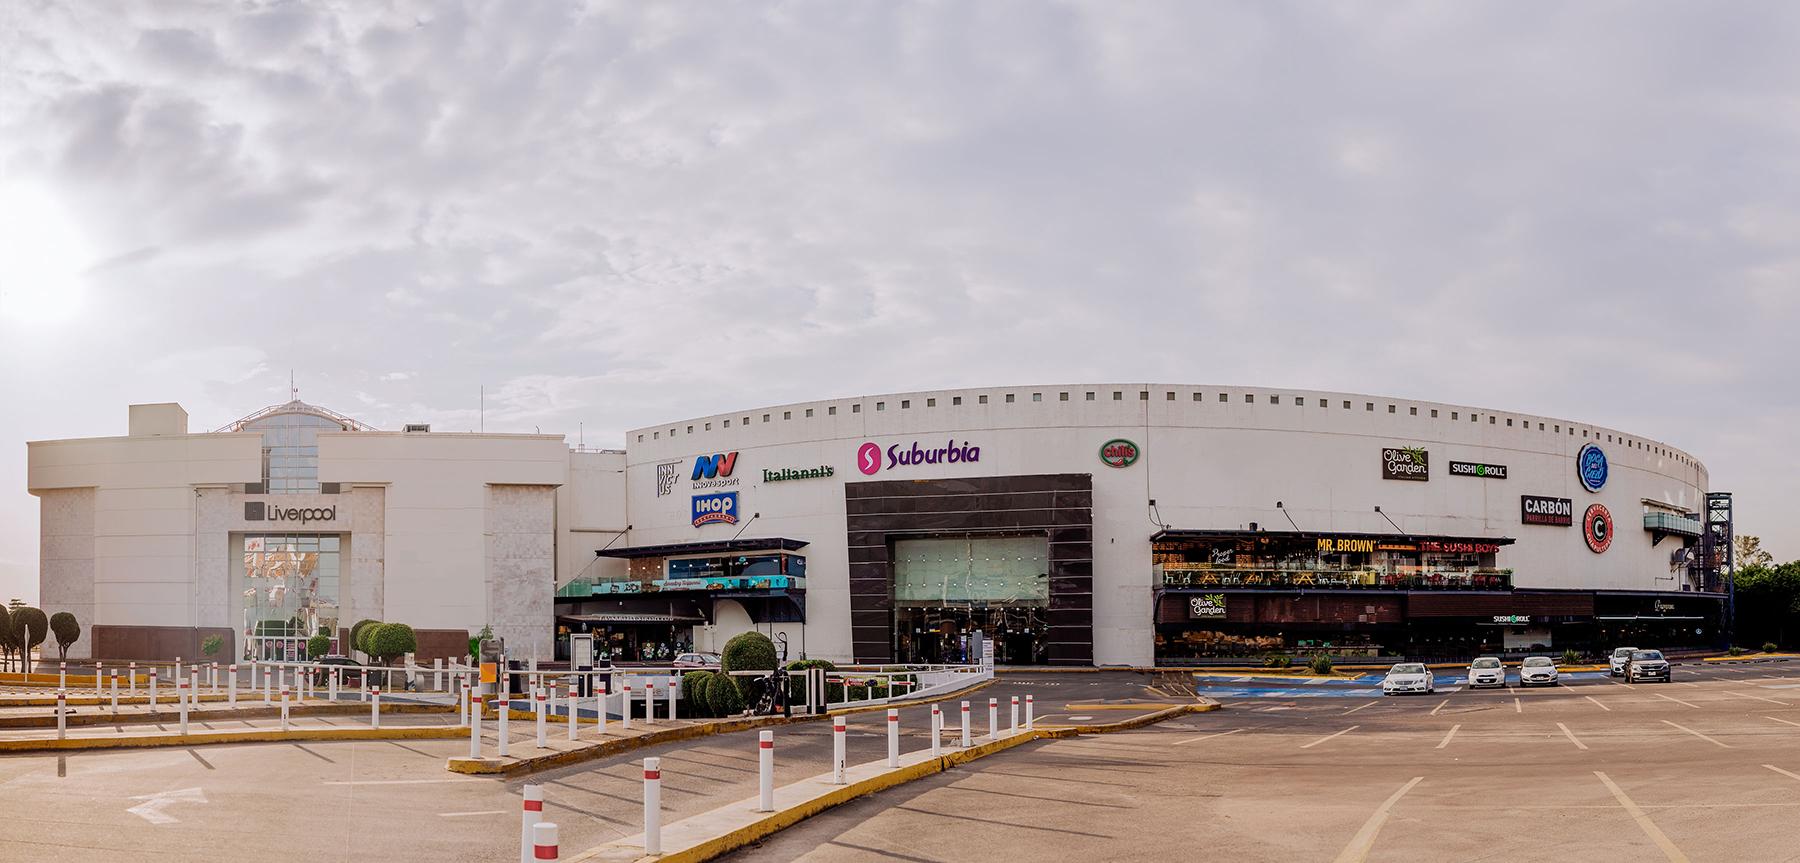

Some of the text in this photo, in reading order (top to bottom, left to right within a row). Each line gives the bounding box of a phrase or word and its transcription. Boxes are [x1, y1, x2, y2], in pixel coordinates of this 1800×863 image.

[886, 439, 980, 470] Suburbia
[1383, 449, 1412, 462] Olive
[762, 464, 834, 483] Italianni's
[1388, 460, 1427, 475] Garden
[1452, 463, 1505, 476] SUSHI ROLL
[1525, 497, 1570, 515] CARBÓN
[268, 505, 336, 525] Liverpool
[1594, 520, 1604, 537] C
[1317, 538, 1374, 552] MR. BROWN
[1420, 541, 1500, 553] THE SUSHI BOYS
[1190, 597, 1213, 607] Olive
[1193, 605, 1226, 616] Garden
